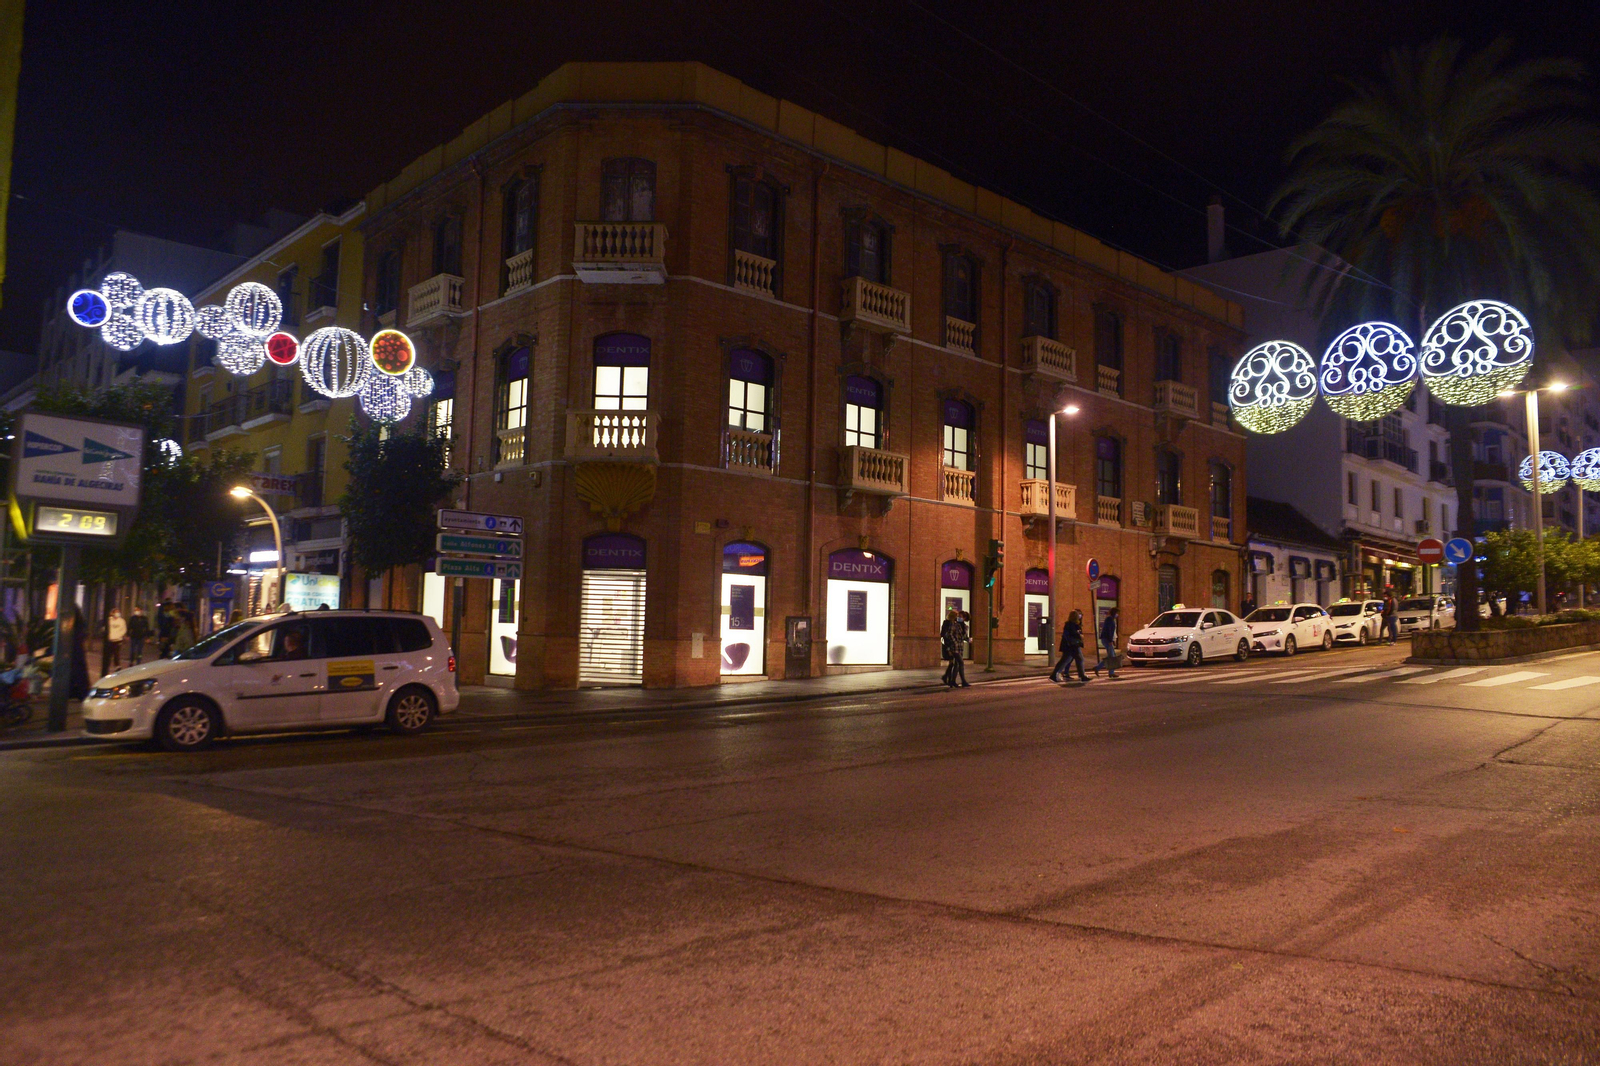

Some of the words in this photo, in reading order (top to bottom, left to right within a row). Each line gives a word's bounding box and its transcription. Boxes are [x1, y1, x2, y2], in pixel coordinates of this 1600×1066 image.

[597, 346, 650, 354] DENTIX
[64, 477, 76, 486] DE
[78, 479, 124, 491] ALGECIRAS
[460, 540, 486, 549] Alfonso
[587, 548, 643, 557] DENTIX
[833, 562, 882, 574] DENTIX
